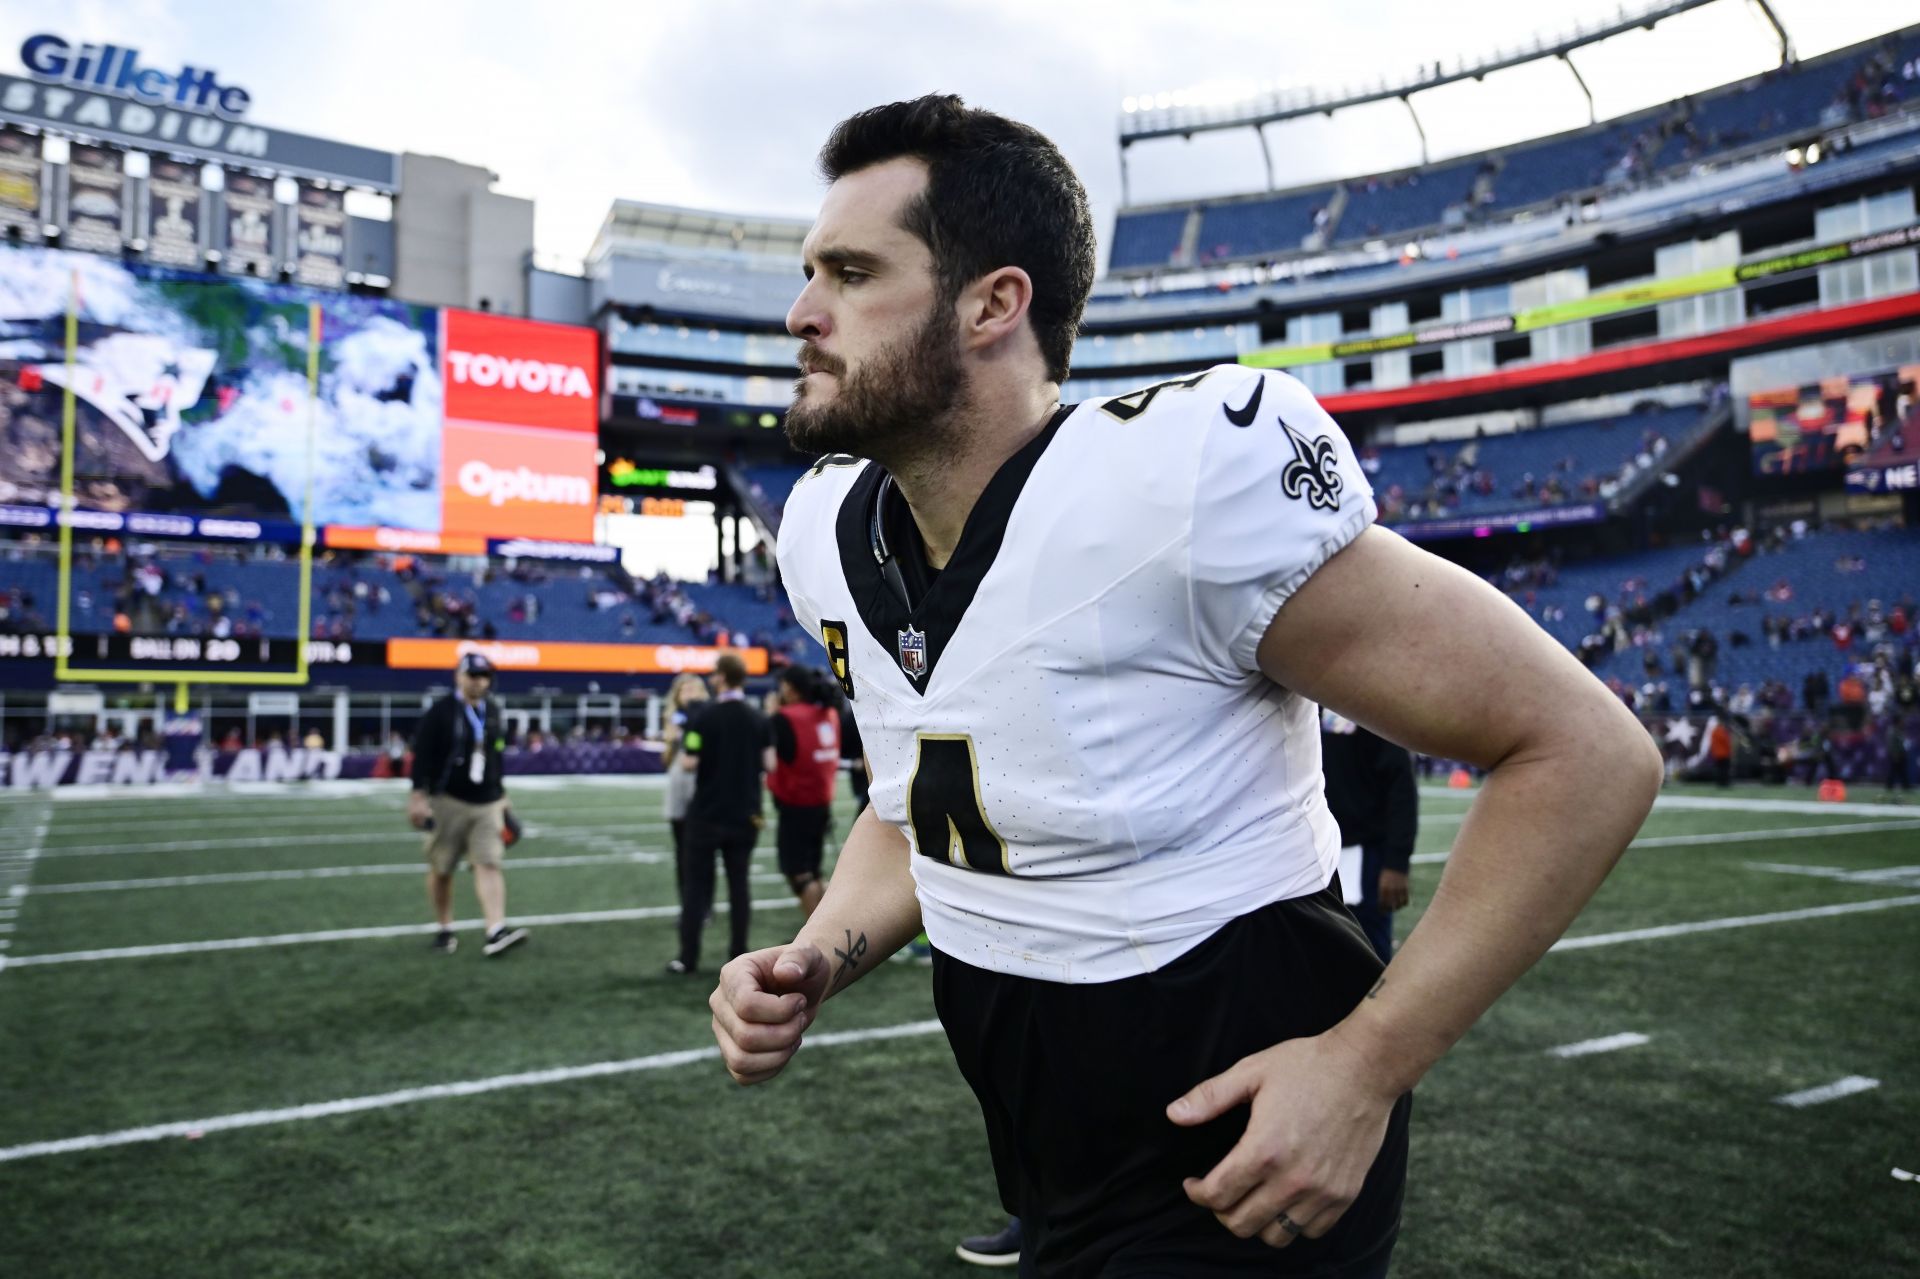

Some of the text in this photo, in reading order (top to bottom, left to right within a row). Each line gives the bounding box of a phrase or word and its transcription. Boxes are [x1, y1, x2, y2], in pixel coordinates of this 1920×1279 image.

[20, 34, 252, 115] Gillette
[2, 81, 269, 157] STADIUM
[448, 350, 592, 398] TOYOTA
[459, 460, 591, 506] Optum
[822, 626, 845, 679] C
[903, 649, 923, 671] NFL
[77, 750, 342, 784] ENLAND
